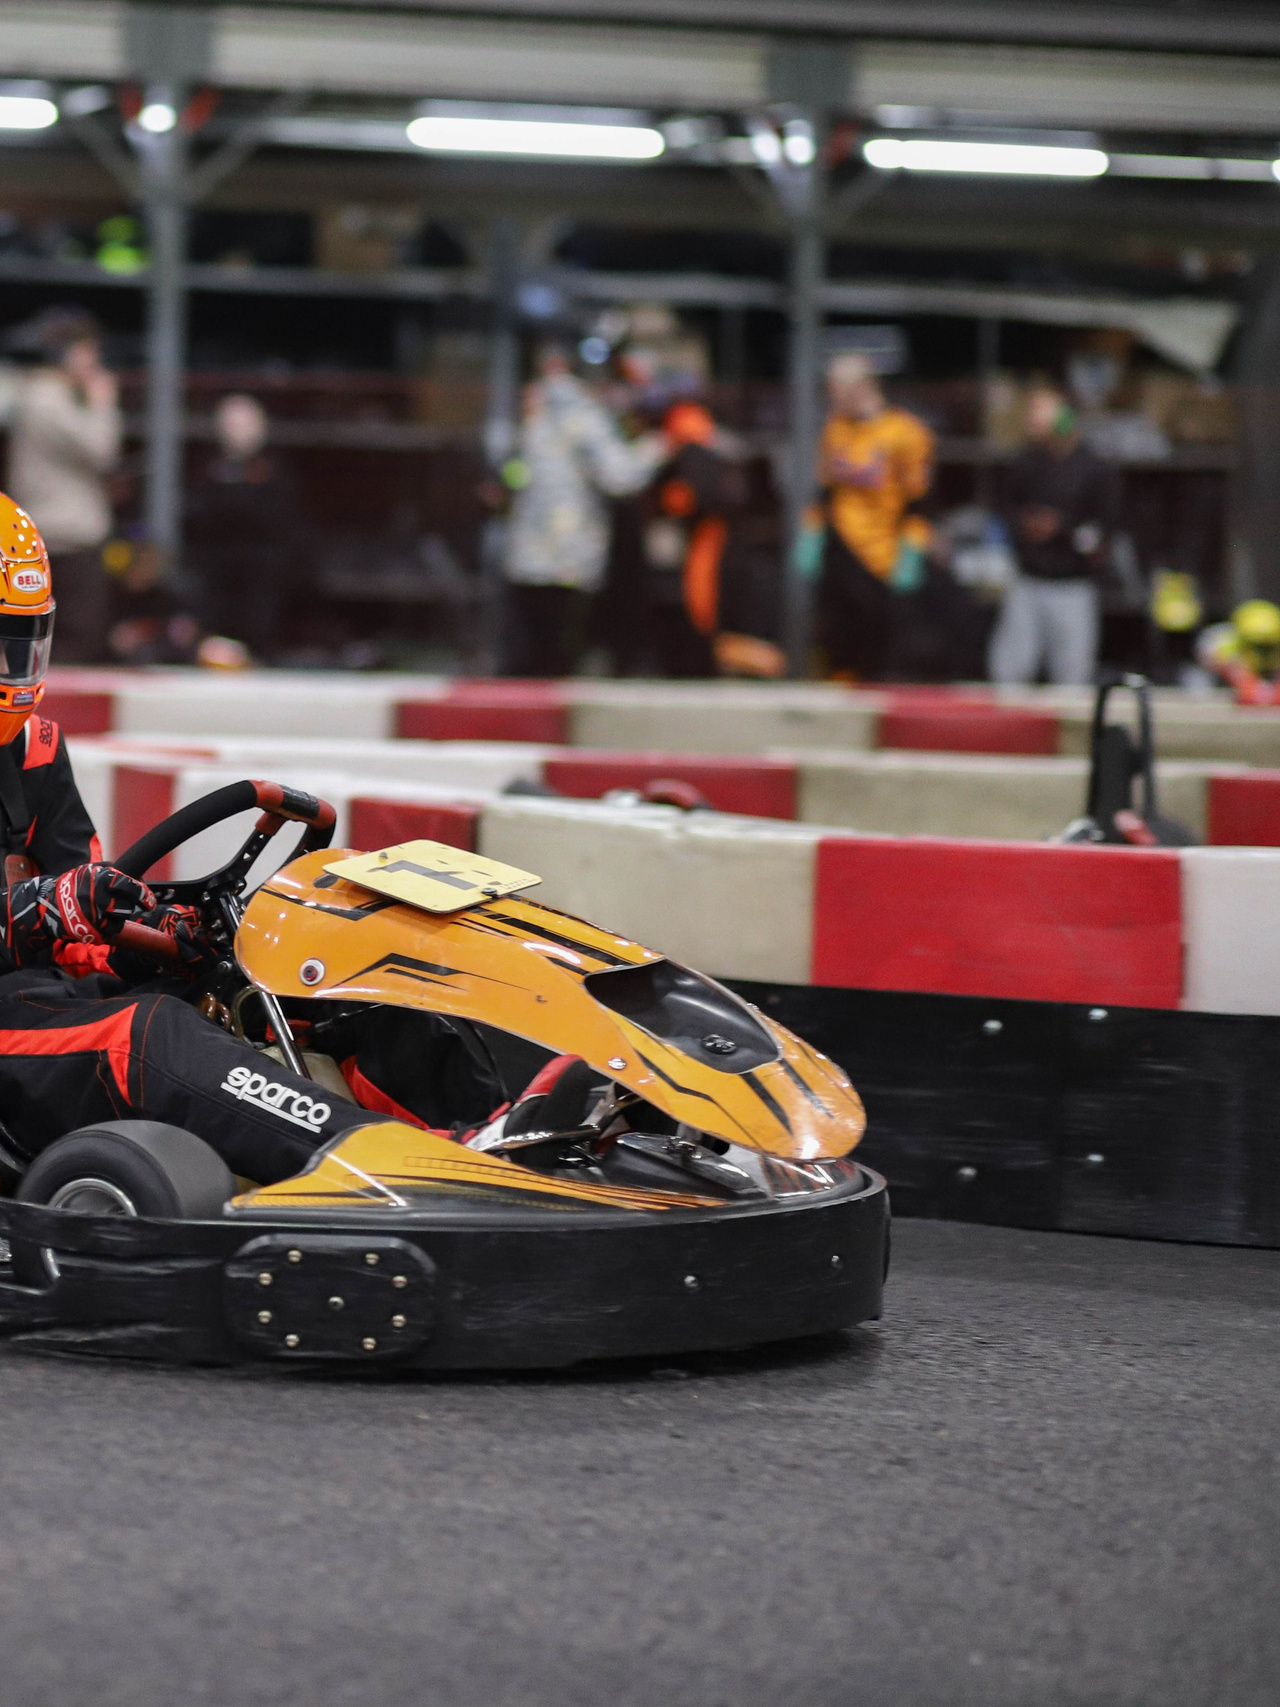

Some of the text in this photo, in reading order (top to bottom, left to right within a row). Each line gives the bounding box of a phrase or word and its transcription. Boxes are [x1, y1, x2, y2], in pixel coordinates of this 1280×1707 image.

[18, 575, 41, 585] BELL
[59, 872, 95, 944] sparco
[220, 1066, 331, 1134] sparco
